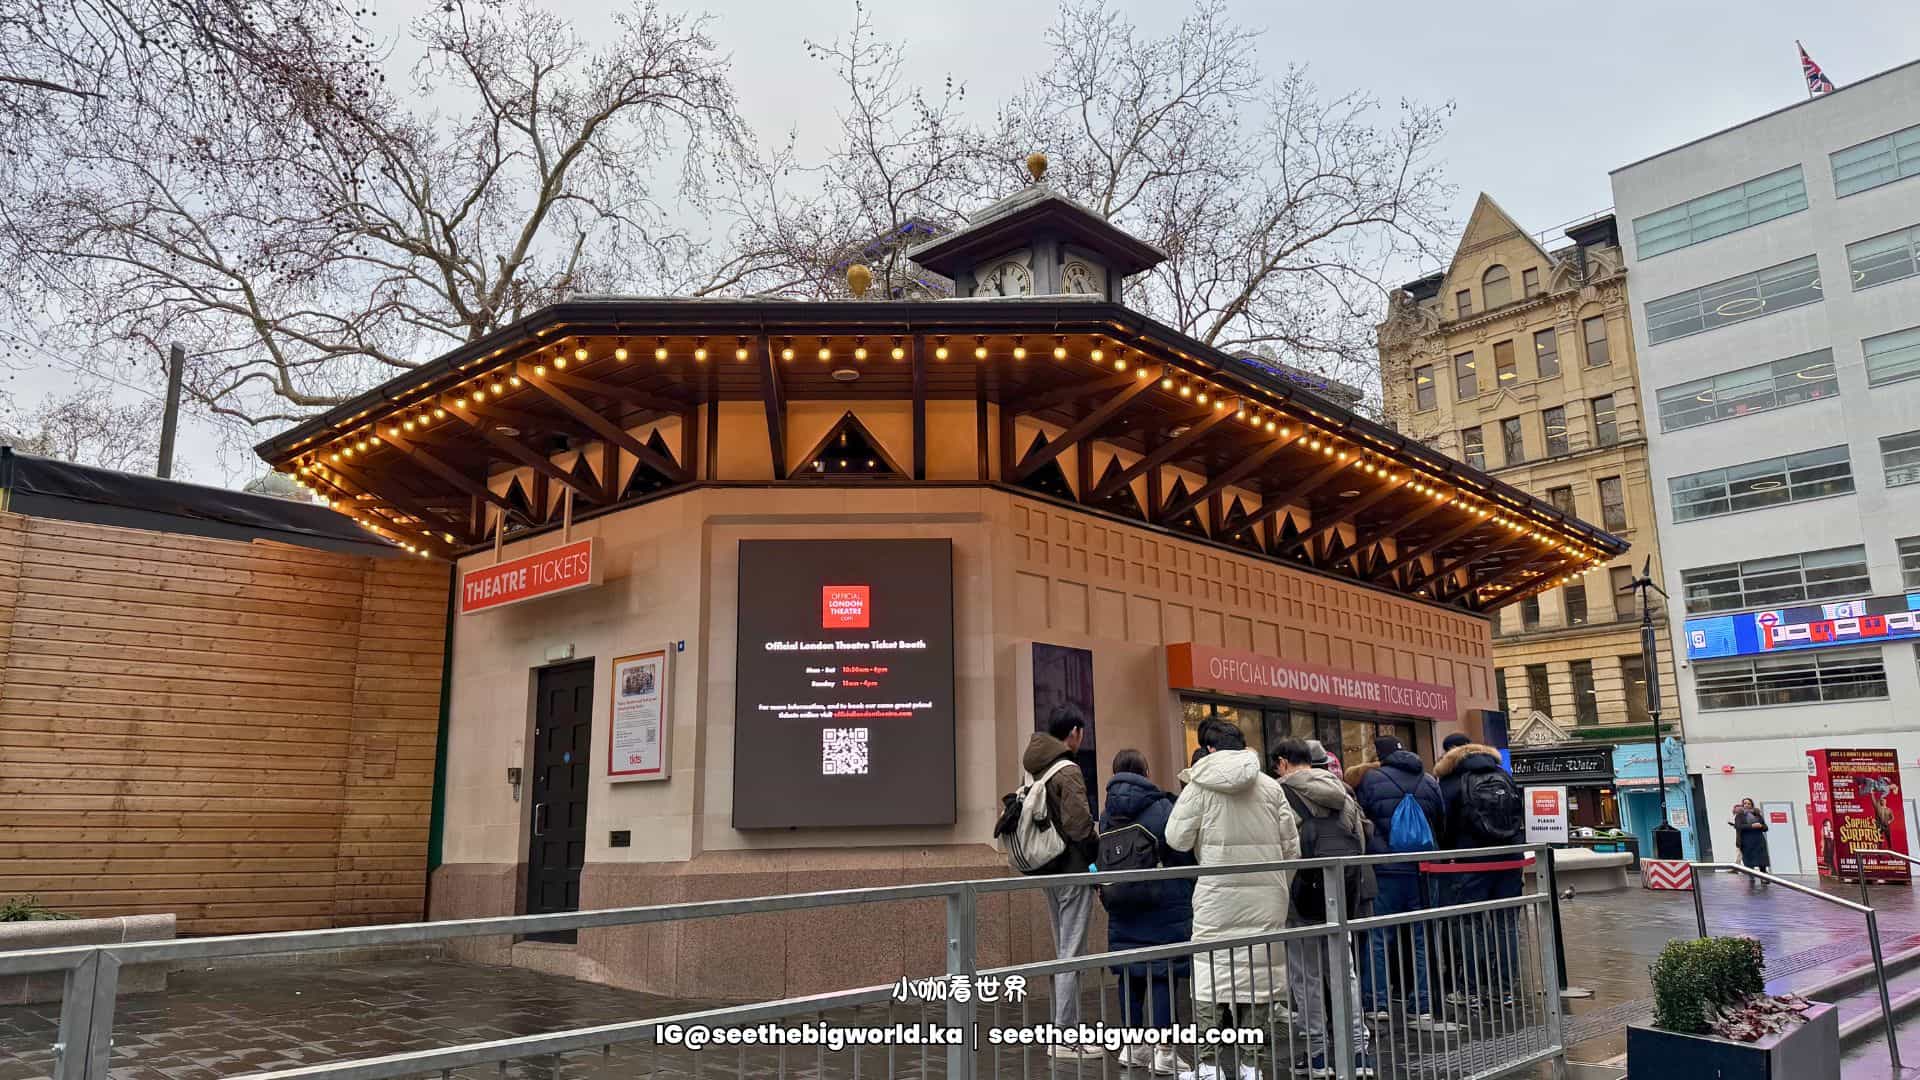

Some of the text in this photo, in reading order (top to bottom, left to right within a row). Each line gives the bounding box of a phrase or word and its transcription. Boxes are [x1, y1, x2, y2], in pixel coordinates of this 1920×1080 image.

[466, 552, 588, 603] THEATRE TICKETS
[831, 607, 862, 615] THEATRE
[765, 640, 927, 650] Official London Theatre Ticket Booth
[811, 680, 836, 688] Sunday
[1209, 657, 1448, 711] OFFICIAL LONDON THEATRE TICKET BOOTH
[1534, 757, 1564, 773] Under
[1566, 759, 1598, 772] Water
[1840, 825, 1885, 844] SURPRISE
